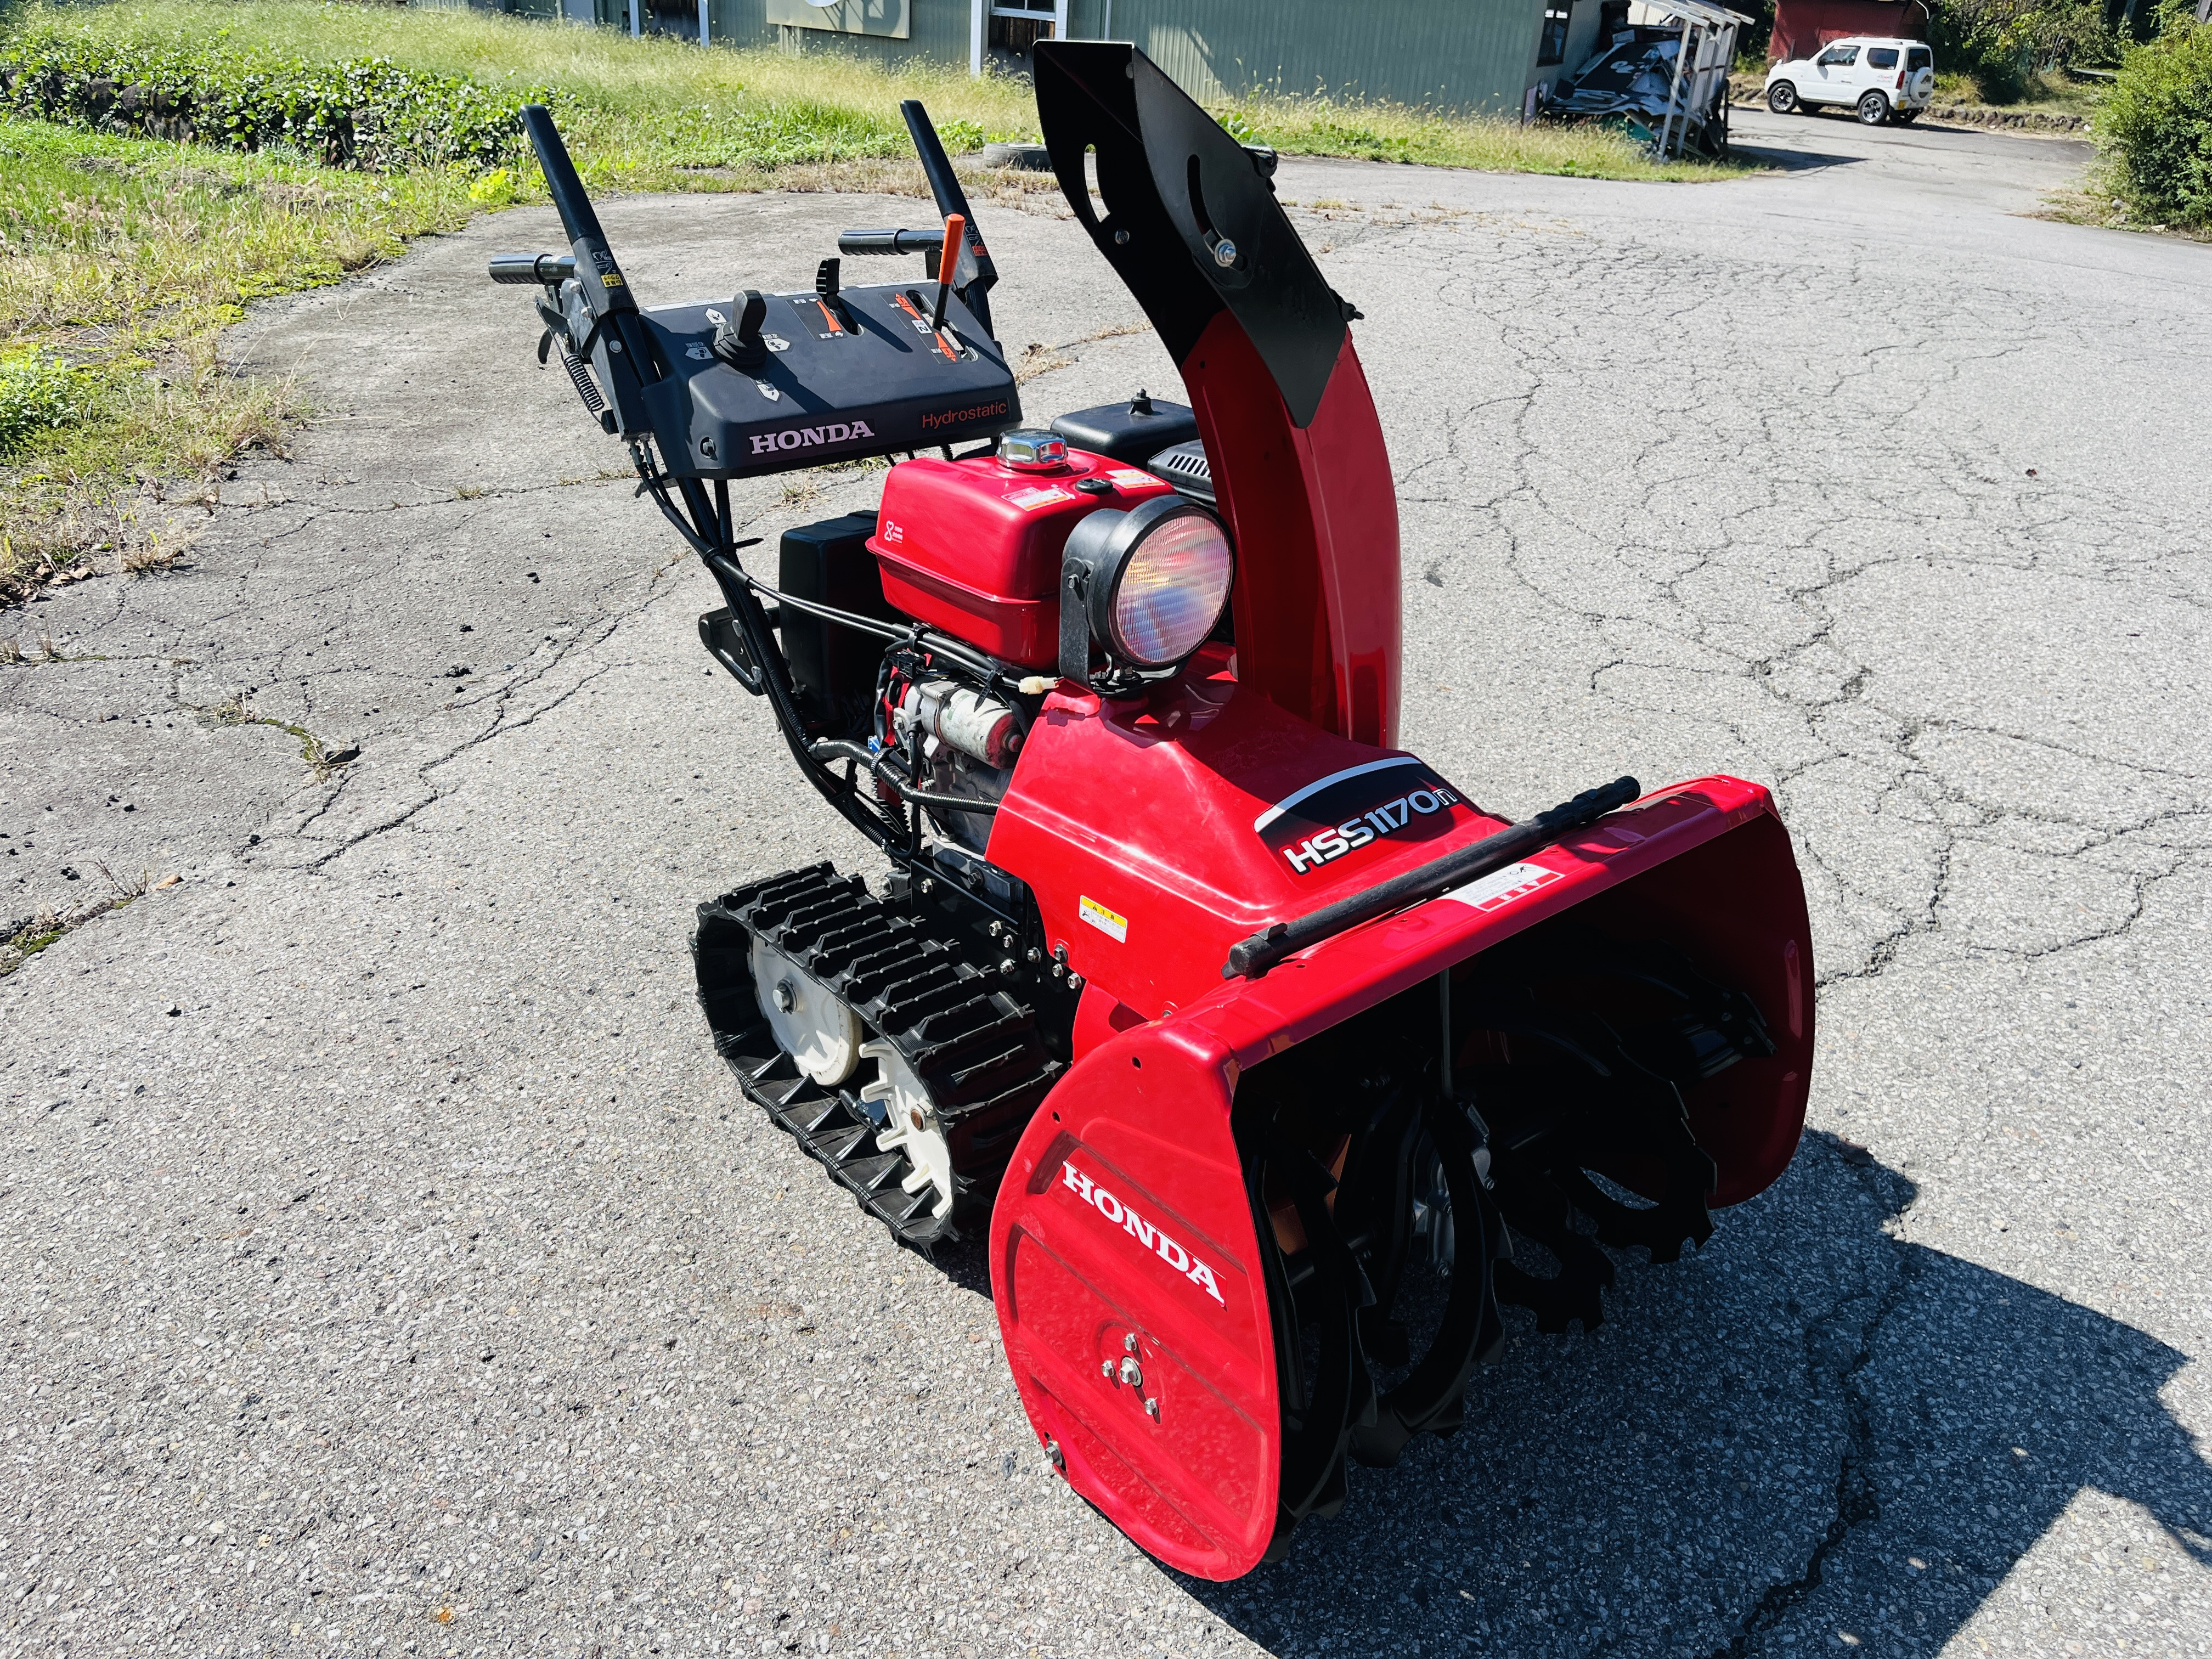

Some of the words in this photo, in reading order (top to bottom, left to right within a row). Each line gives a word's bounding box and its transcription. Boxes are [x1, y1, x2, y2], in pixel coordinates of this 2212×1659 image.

[922, 401, 1007, 430] Hydrostatic
[749, 420, 875, 454] HONDA
[1063, 1160, 1225, 1304] HONDA
